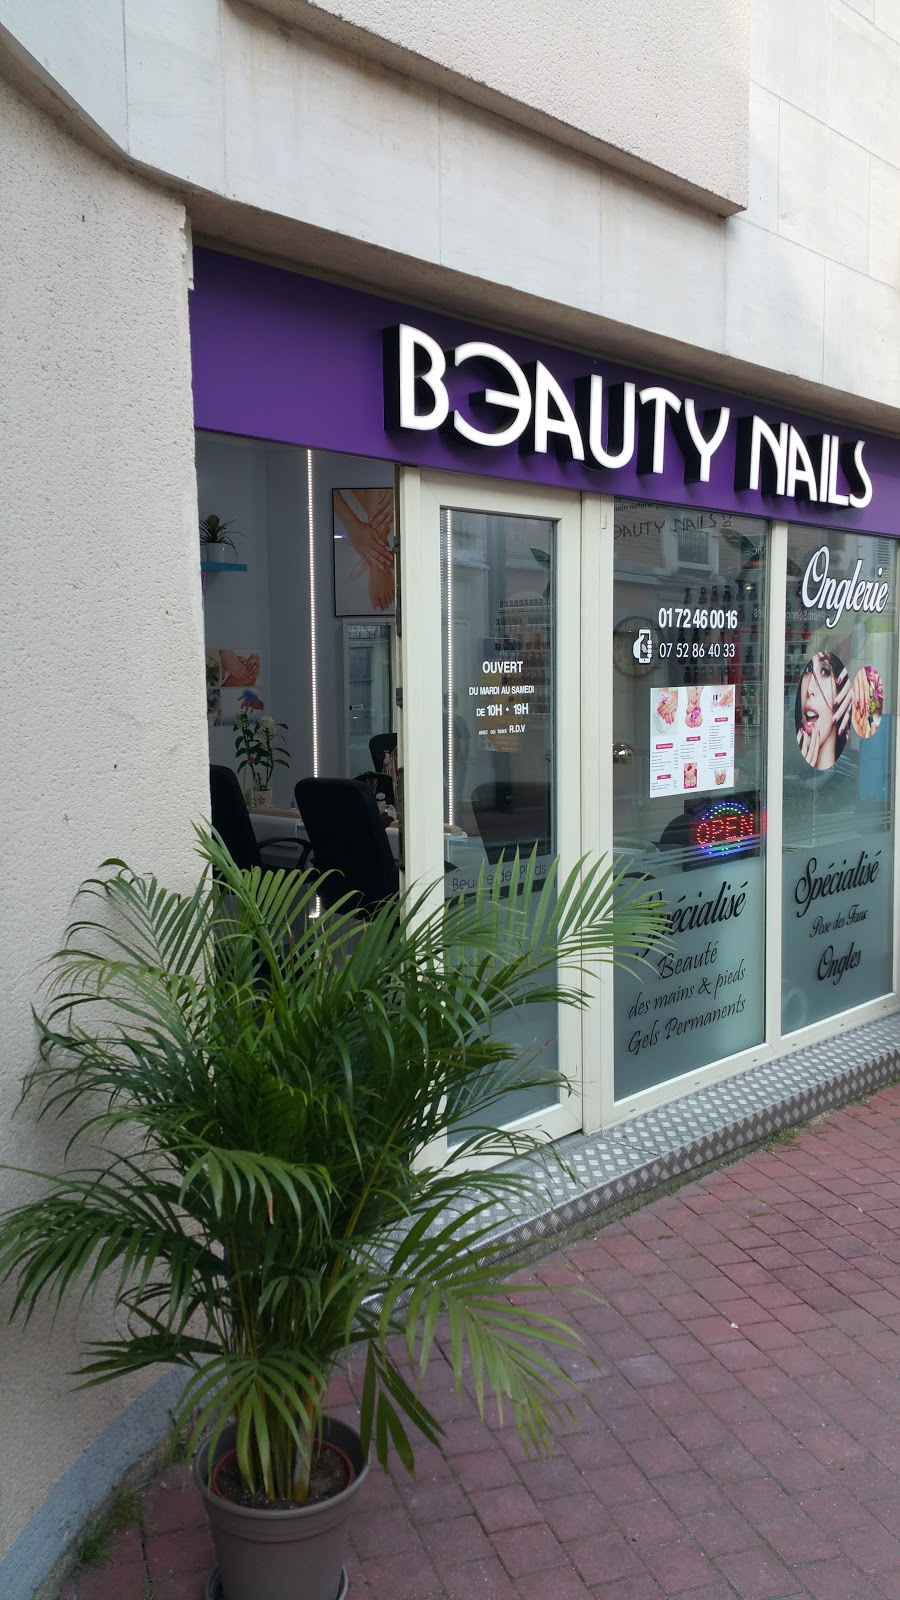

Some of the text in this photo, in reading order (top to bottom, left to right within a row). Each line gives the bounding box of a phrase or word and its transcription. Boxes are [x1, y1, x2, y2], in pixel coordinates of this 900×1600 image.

[397, 323, 873, 508] BEAUTY NAILS
[802, 545, 889, 629] Onglerie
[482, 661, 524, 674] OUVERT
[659, 642, 735, 658] 07 52 86 40 33
[468, 685, 535, 696] DU MARDI AU SAMEDI
[476, 708, 486, 717] DE
[486, 704, 503, 716] 10H
[513, 703, 529, 715] 19H
[696, 813, 754, 845] OPEN
[520, 862, 547, 879] Pids
[794, 850, 883, 918] Spécialisé
[832, 912, 846, 931] des
[846, 903, 869, 926] Faux
[657, 940, 719, 980] Beauté
[817, 941, 862, 985] Ongles
[628, 958, 746, 1020] des mains & pieds
[627, 993, 747, 1056] Gels Permanents
